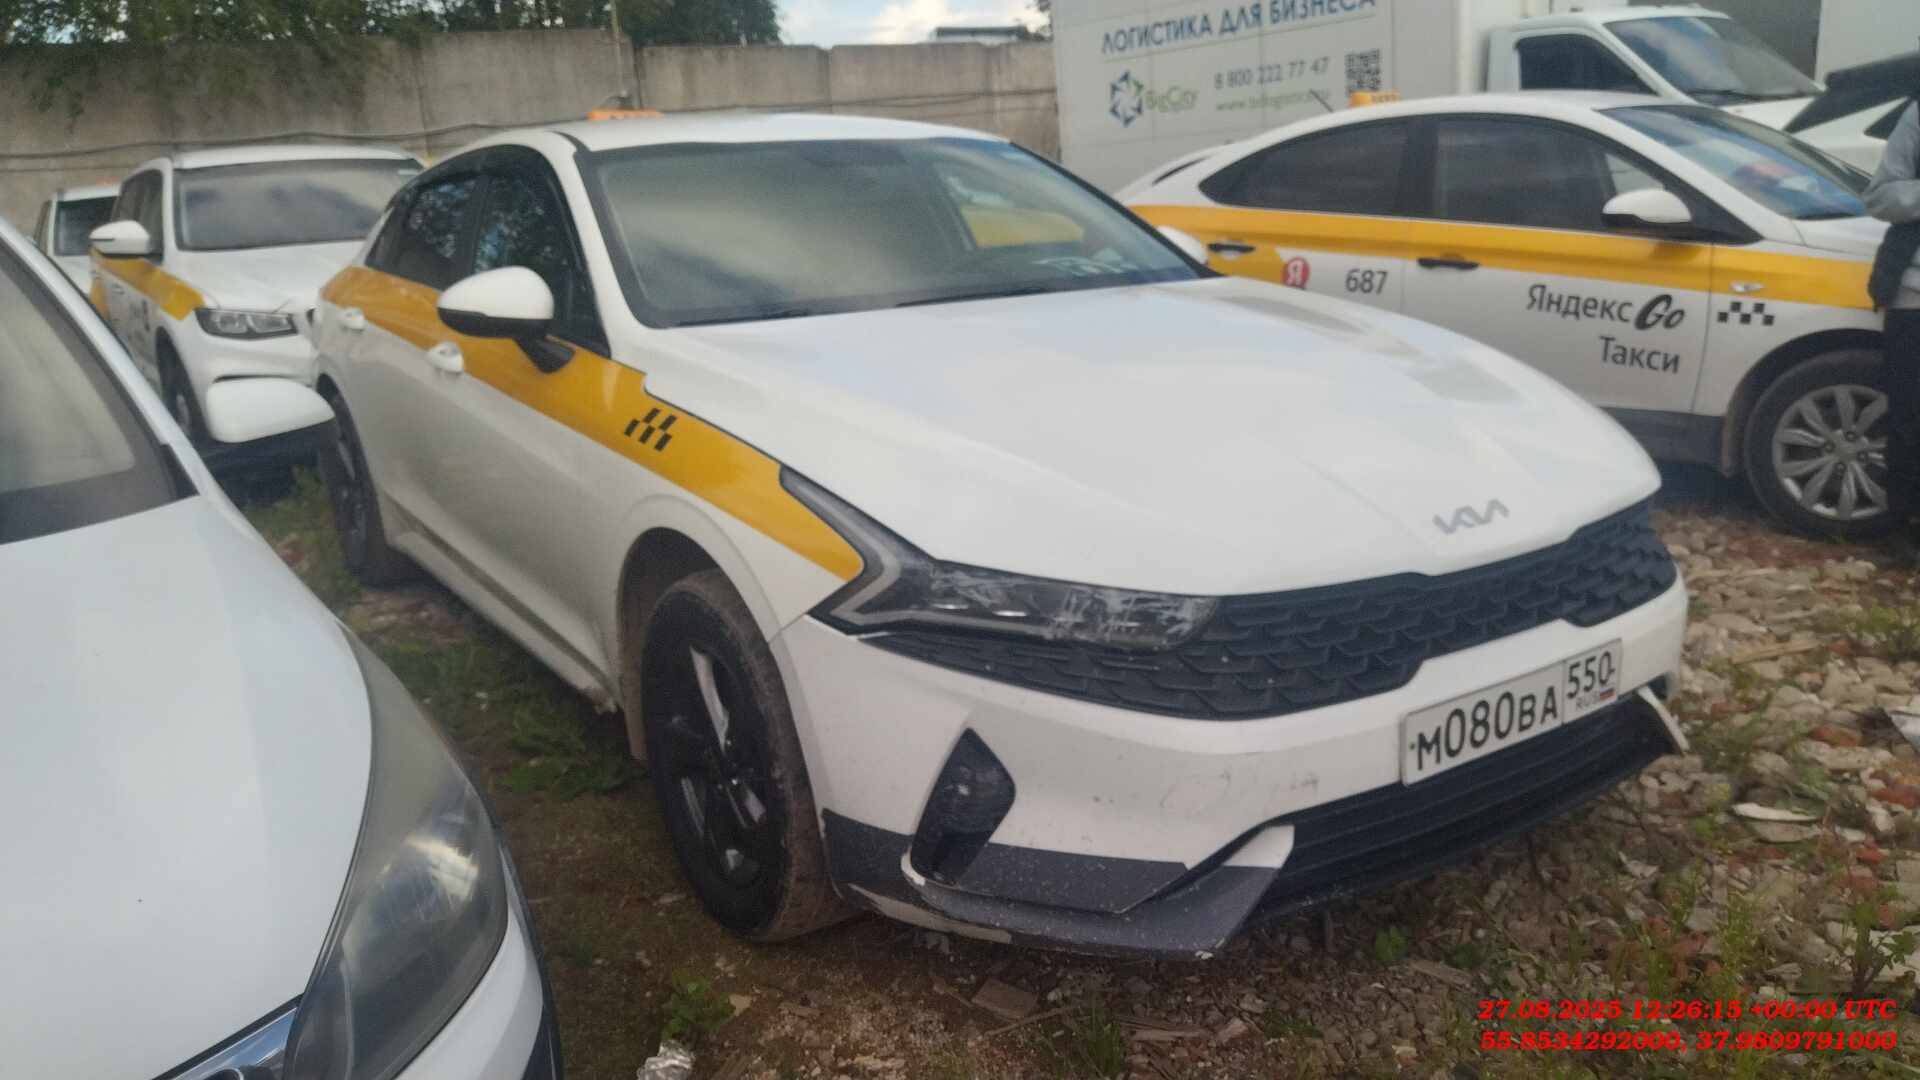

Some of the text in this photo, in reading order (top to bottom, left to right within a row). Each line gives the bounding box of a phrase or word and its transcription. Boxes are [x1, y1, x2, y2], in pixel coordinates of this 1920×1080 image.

[1101, 13, 1213, 54] ЛОГИСТИКА
[1219, 3, 1263, 35] ДЛЯ
[1214, 56, 1329, 90] 8 800 222 77 47
[1345, 268, 1388, 295] 687
[1526, 283, 1686, 331] Яндекс Go
[1599, 335, 1681, 375] Такси
[1566, 651, 1616, 699] 550
